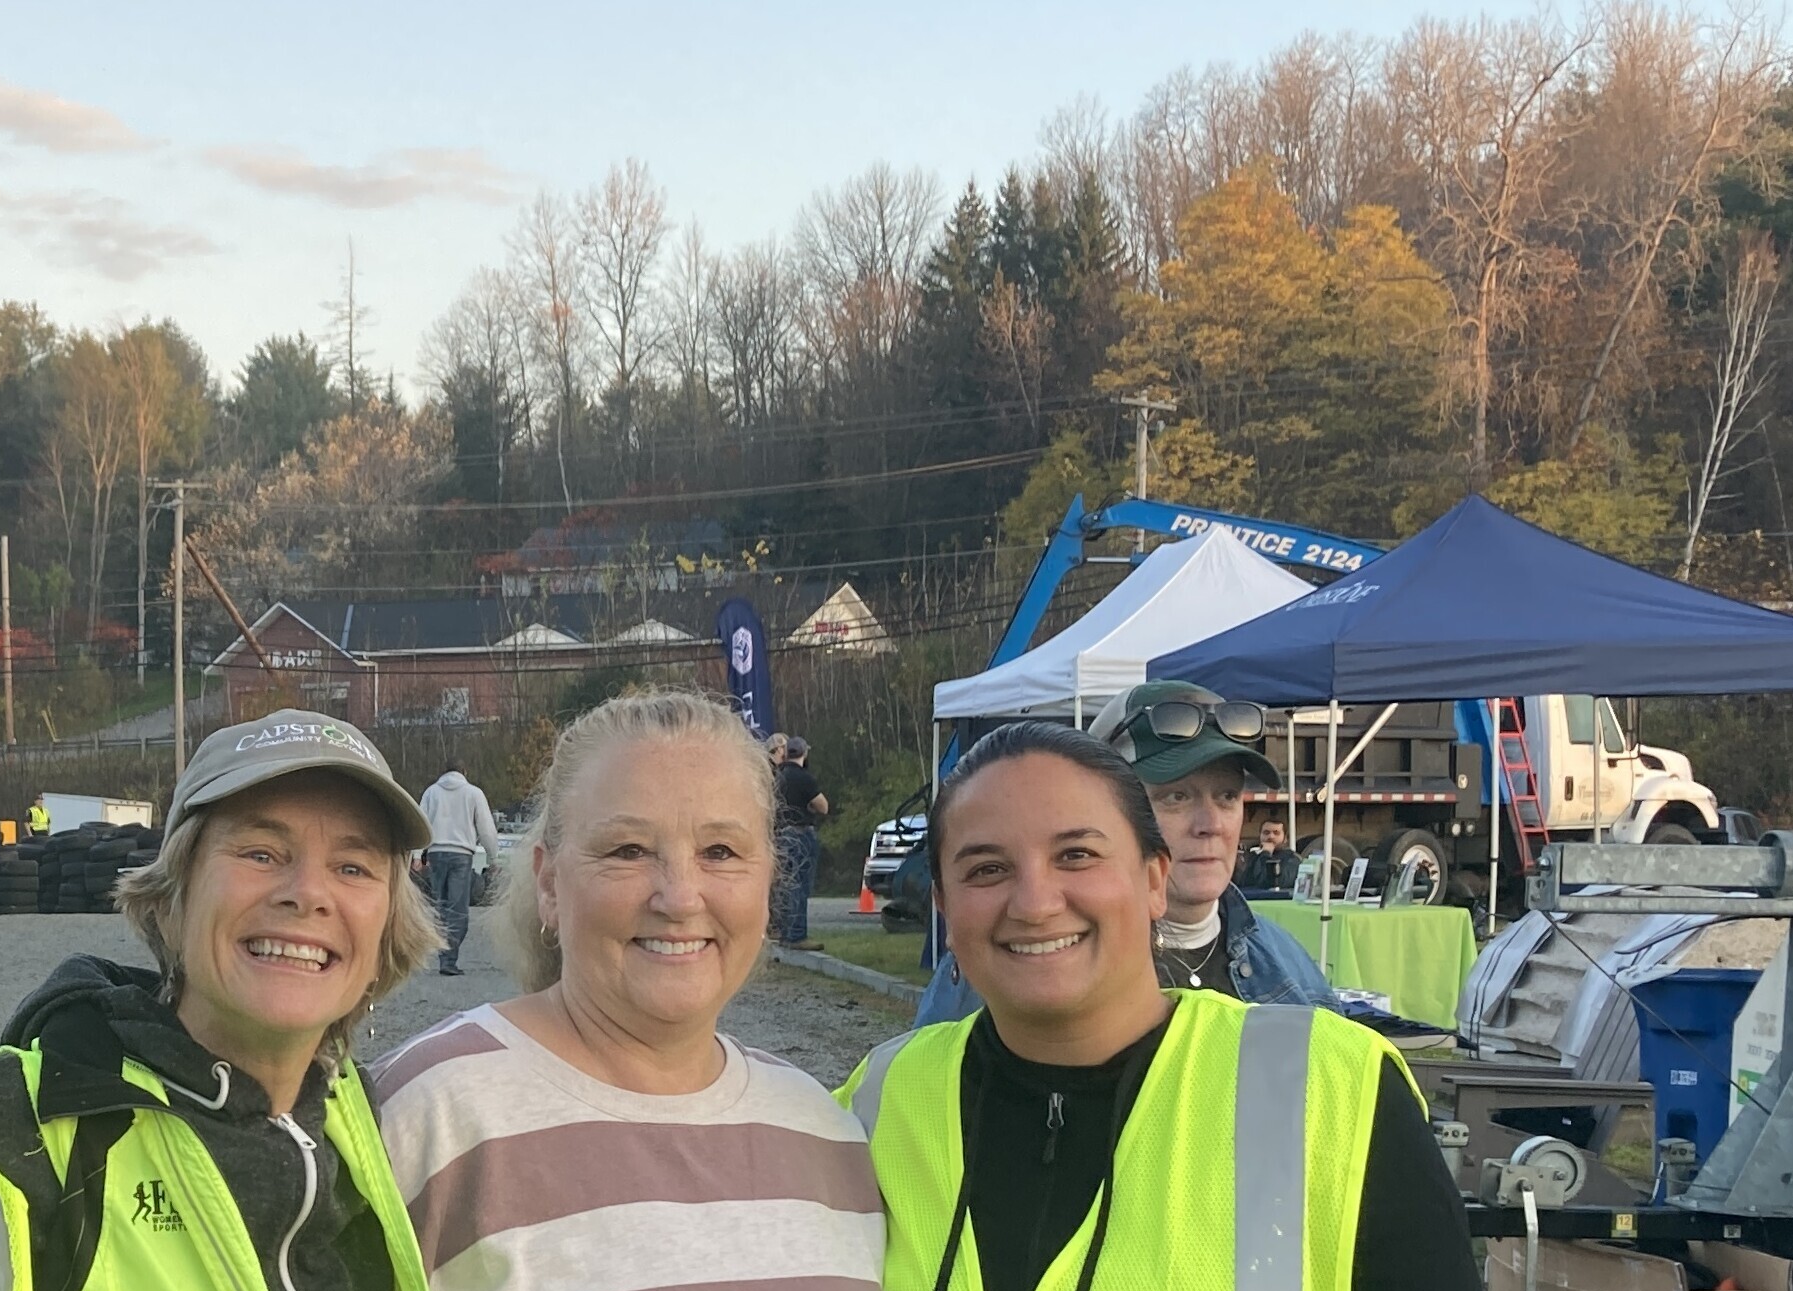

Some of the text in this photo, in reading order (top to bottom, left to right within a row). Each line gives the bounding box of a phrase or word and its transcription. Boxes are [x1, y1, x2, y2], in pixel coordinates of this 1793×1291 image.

[1302, 543, 1364, 572] 2124
[255, 735, 366, 760] COMMUNITY ACTION
